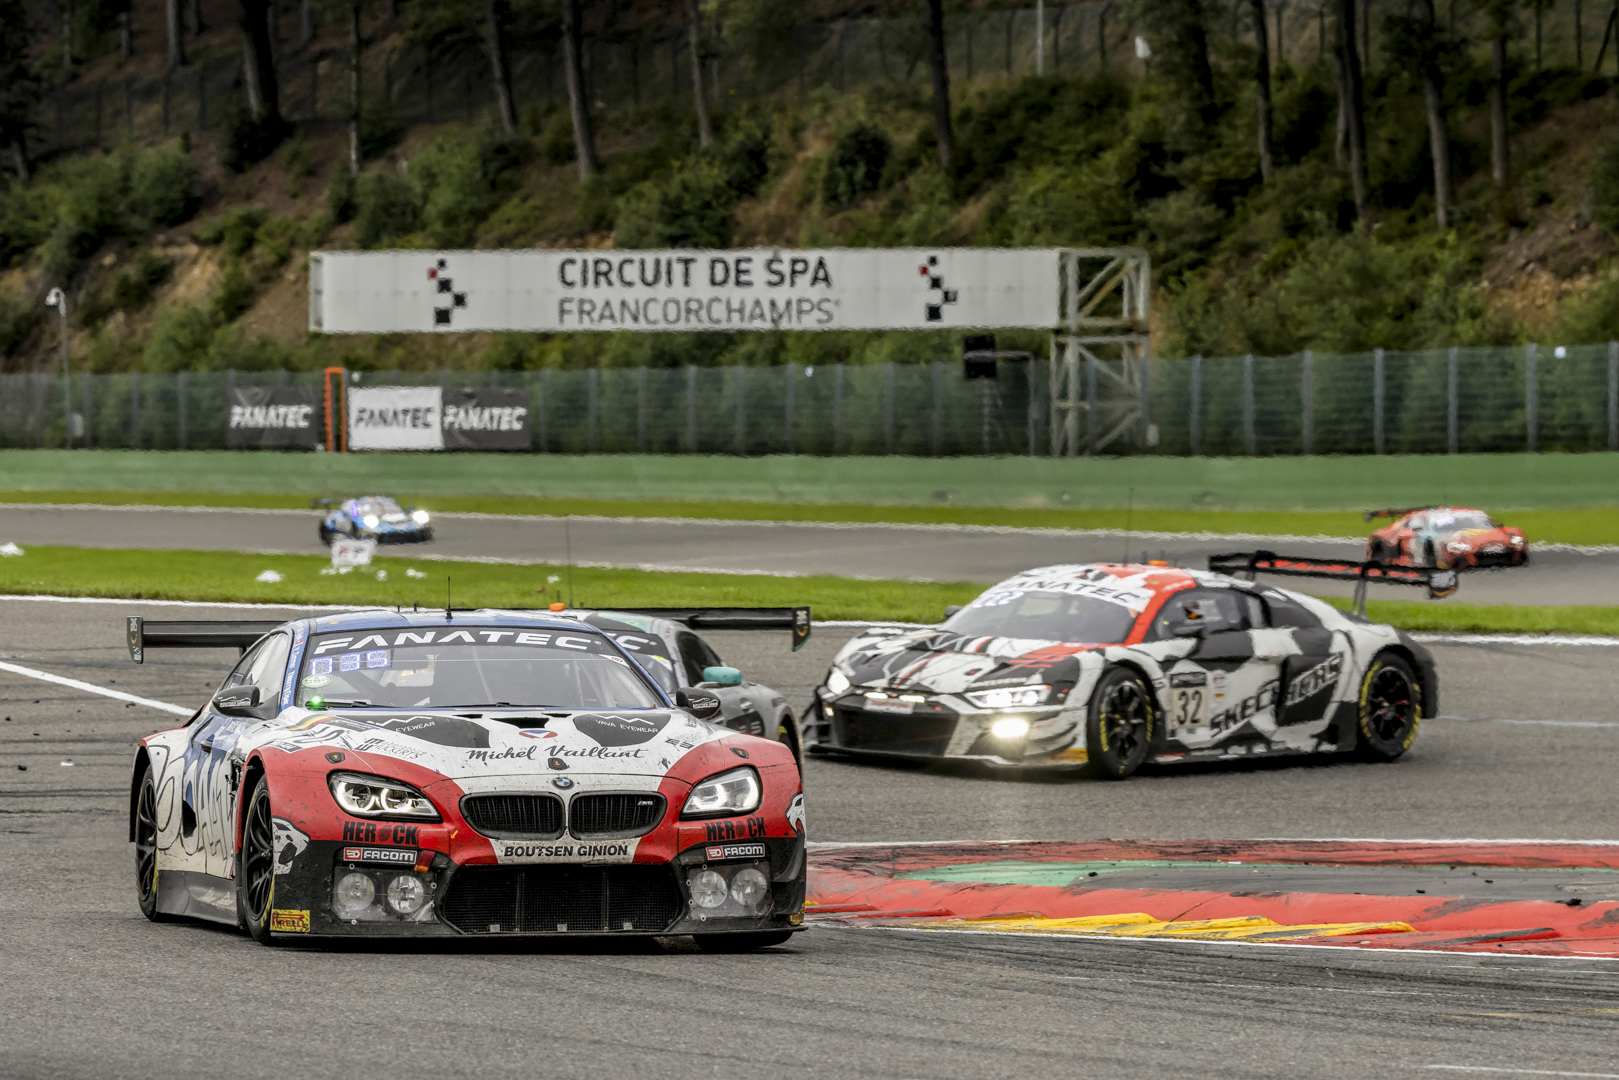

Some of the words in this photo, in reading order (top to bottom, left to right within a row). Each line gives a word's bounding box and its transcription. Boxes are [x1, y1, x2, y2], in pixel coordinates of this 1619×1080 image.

[558, 256, 697, 289] CIRCUIT
[709, 256, 753, 288] DE
[766, 256, 833, 288] SPA
[558, 297, 835, 325] FRANCORCHAMPS
[230, 404, 313, 429] FANATEC
[354, 406, 436, 429] FANATEC
[443, 405, 528, 431] FANATEC
[313, 630, 592, 655] FANATEC
[1176, 690, 1203, 725] 32
[395, 721, 436, 733] EYEWEAR
[595, 719, 617, 728] VAVA
[619, 724, 659, 734] EYEWEAR
[466, 745, 537, 762] Michel
[544, 745, 649, 760] Vaillant
[363, 850, 415, 862] FACOM
[504, 845, 575, 857] BOUTSEN
[577, 845, 629, 857] GINION
[724, 846, 764, 857] FACOM
